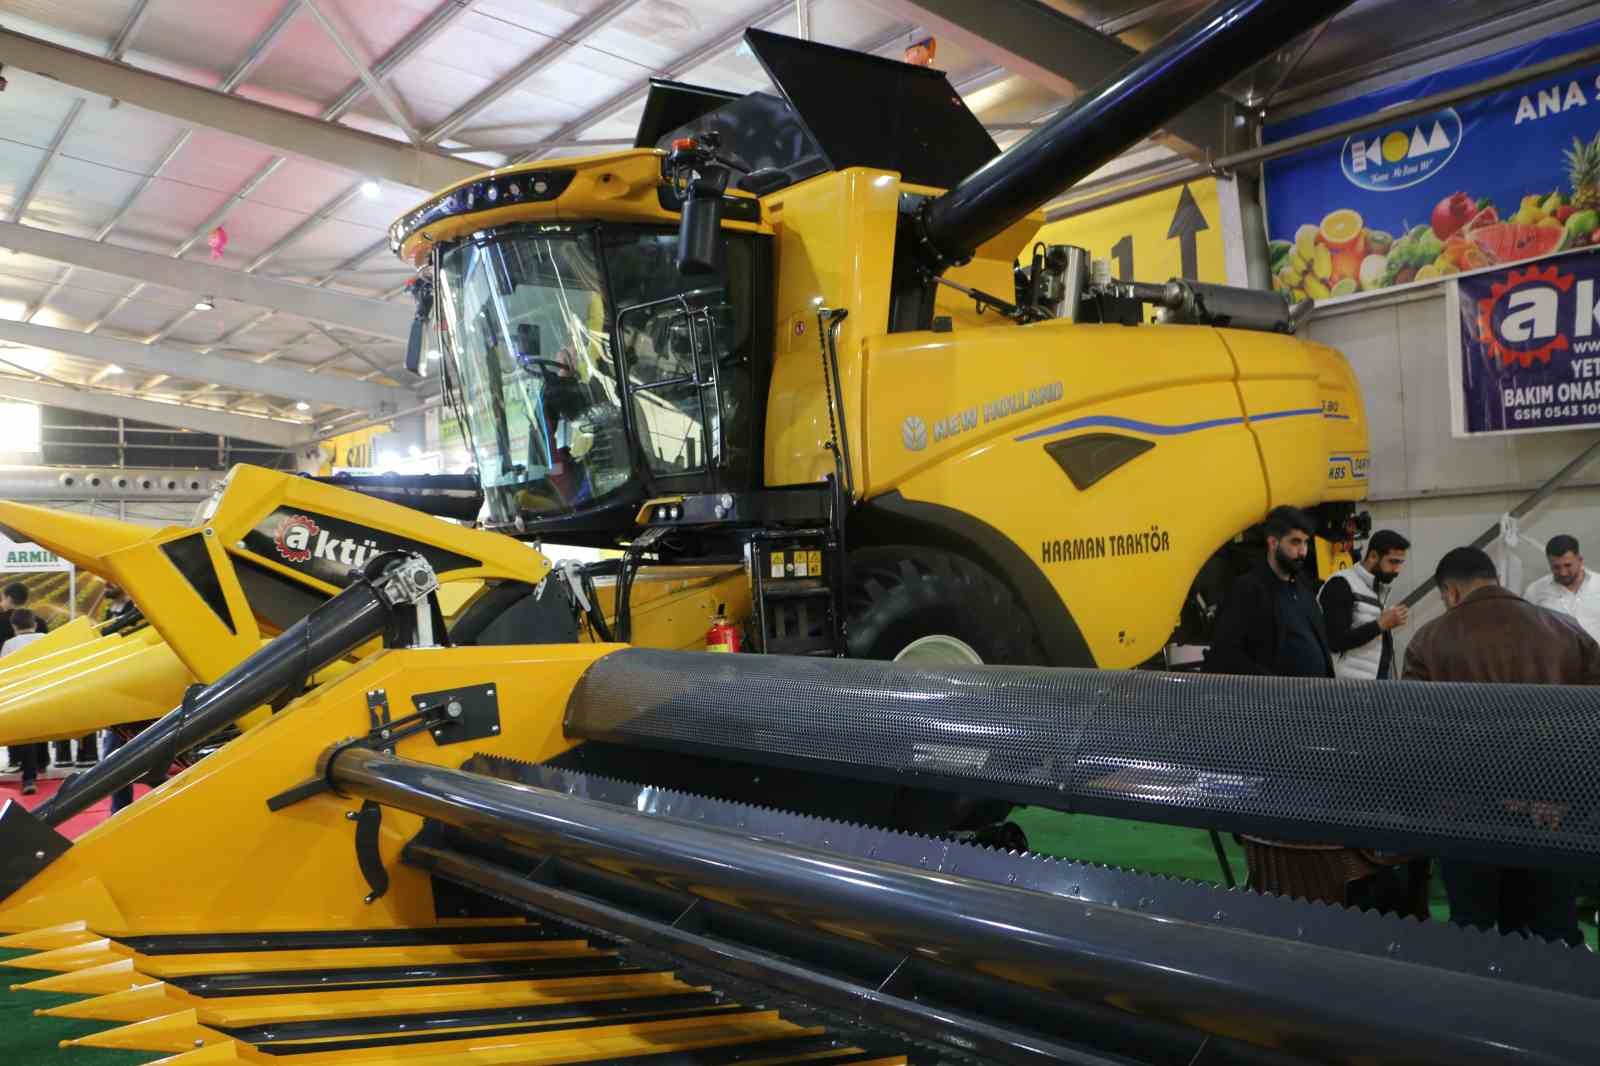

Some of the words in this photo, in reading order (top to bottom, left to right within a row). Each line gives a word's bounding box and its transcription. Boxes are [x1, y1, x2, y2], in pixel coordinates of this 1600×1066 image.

[1514, 81, 1587, 125] ANA
[934, 404, 978, 442] NEW
[984, 380, 1064, 424] HOLLAND
[1504, 384, 1554, 407] BAKIM
[1514, 407, 1542, 421] GSM
[1544, 404, 1579, 419] 0543
[1042, 537, 1106, 564] HARMAN
[1109, 525, 1169, 556] TRAKTÖR
